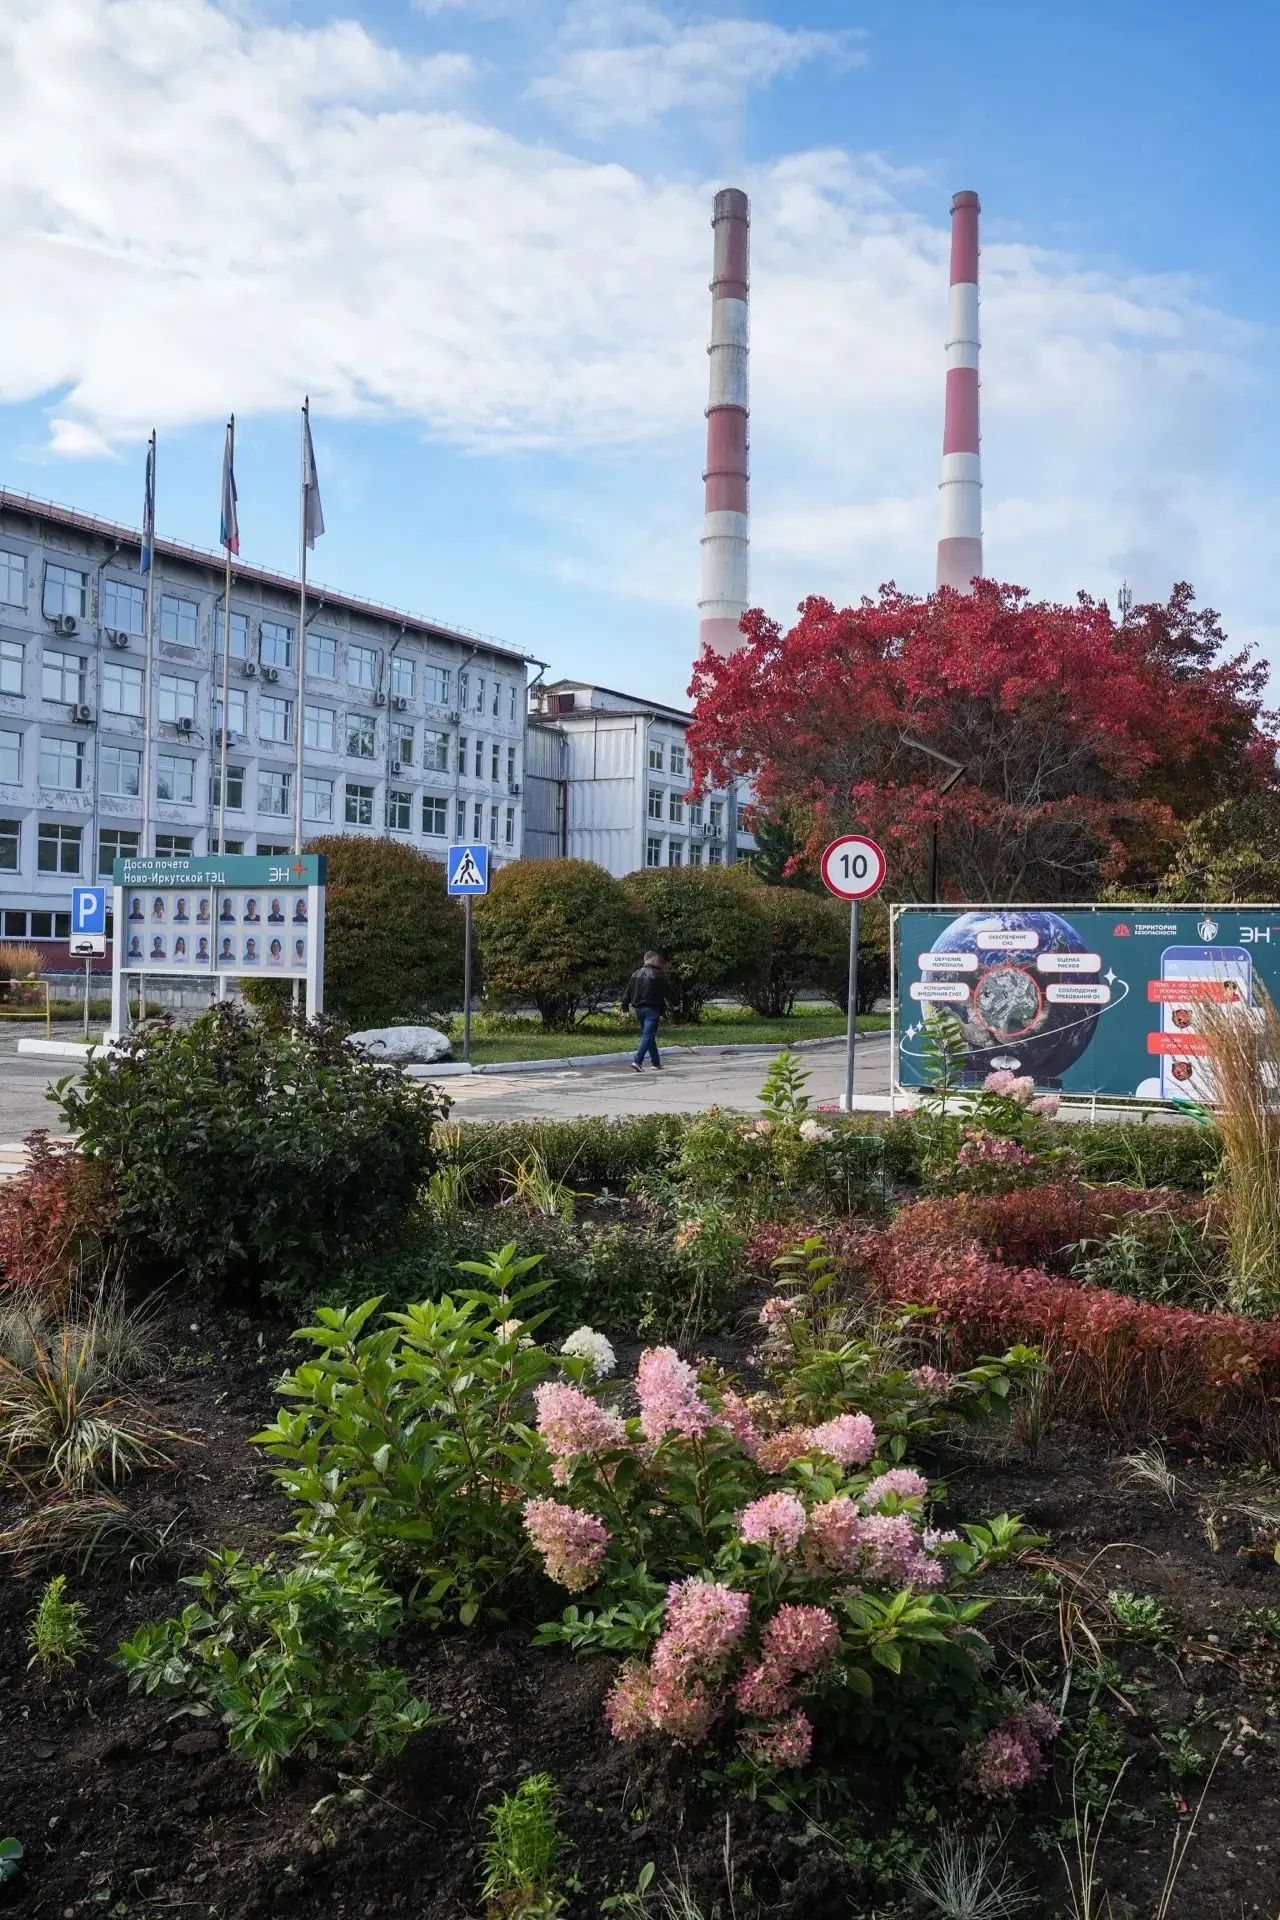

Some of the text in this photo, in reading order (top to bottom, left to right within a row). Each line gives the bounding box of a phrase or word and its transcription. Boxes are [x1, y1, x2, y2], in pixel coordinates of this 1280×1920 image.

[124, 859, 189, 870] Доска почета
[840, 854, 868, 879] 10
[124, 872, 225, 884] Ново-Иркутской ТЭЦ
[79, 892, 98, 928] P
